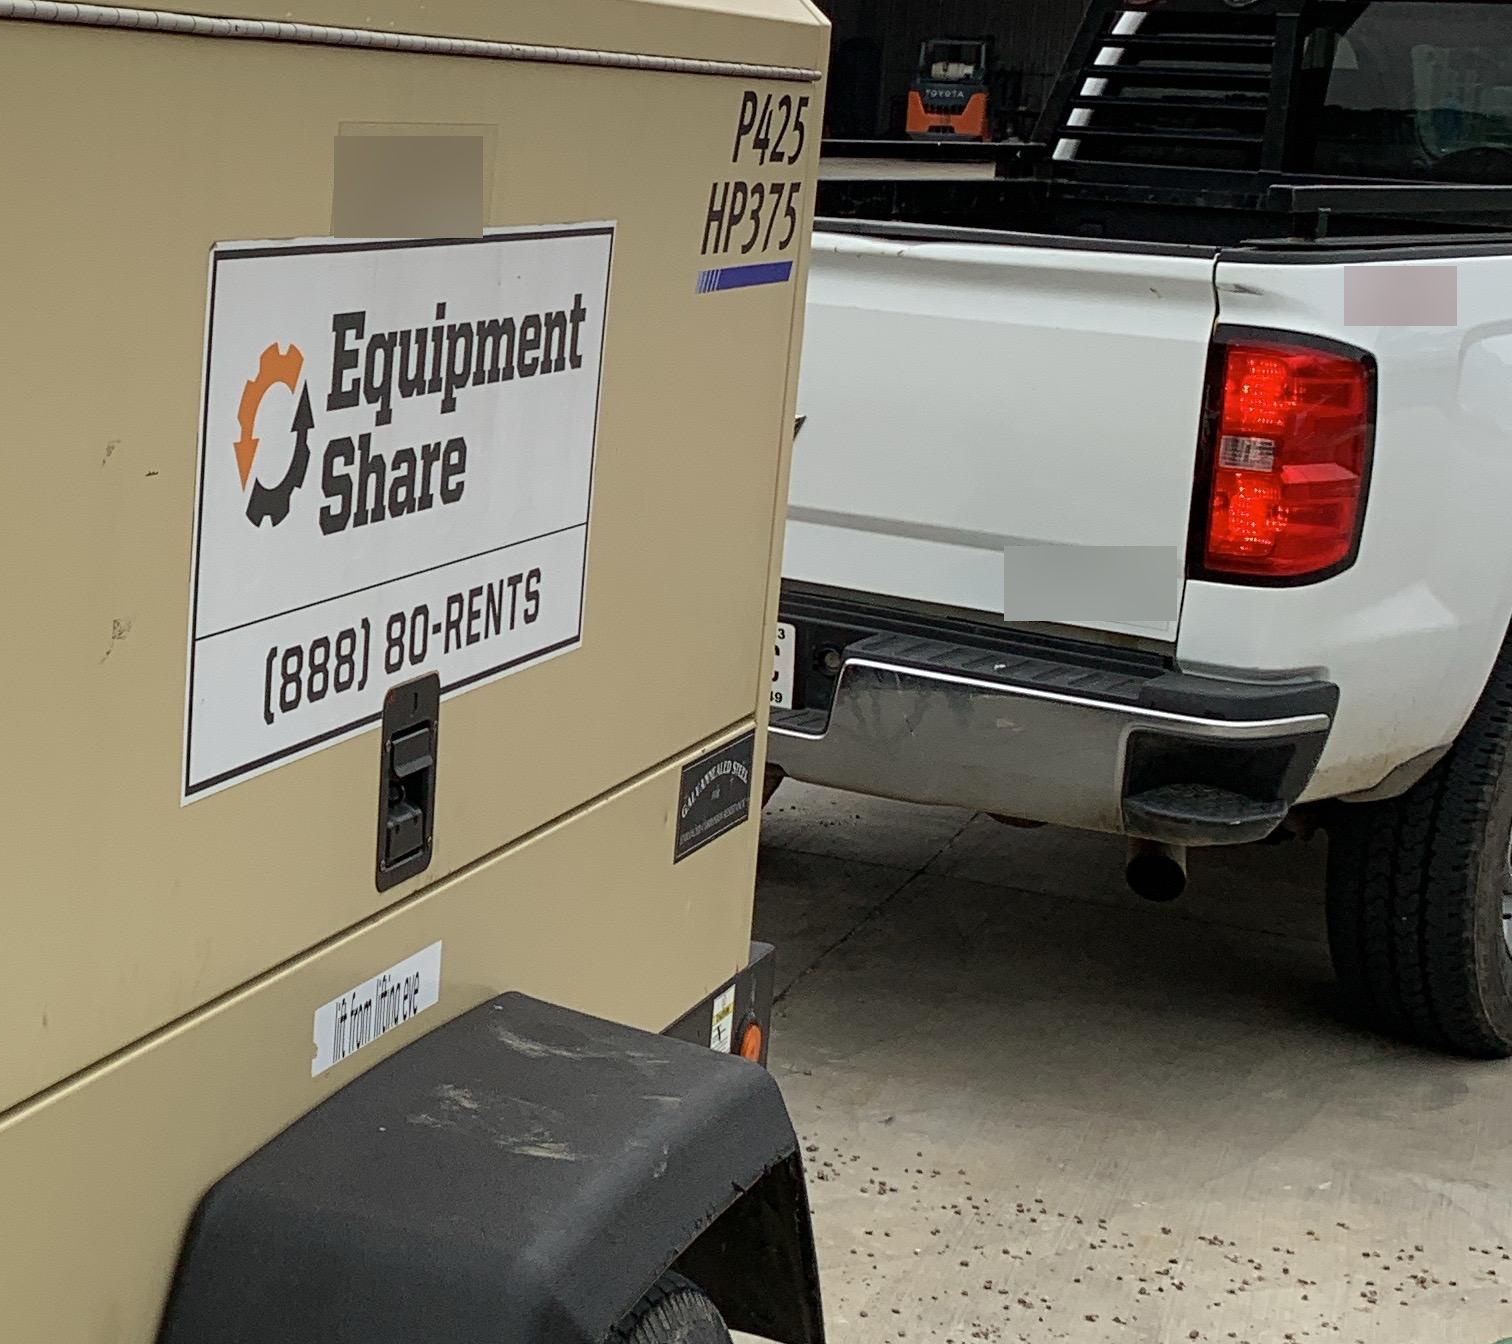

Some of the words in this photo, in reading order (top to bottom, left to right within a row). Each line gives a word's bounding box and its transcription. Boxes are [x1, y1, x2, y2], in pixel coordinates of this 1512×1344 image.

[732, 90, 810, 166] P425
[925, 89, 965, 98] TOYOTA
[701, 180, 802, 256] HP375
[326, 293, 588, 427] Equipment
[318, 436, 468, 536] Share
[263, 617, 371, 726] (888)
[384, 567, 543, 675] 80-RENTS
[732, 760, 748, 785] STEEL
